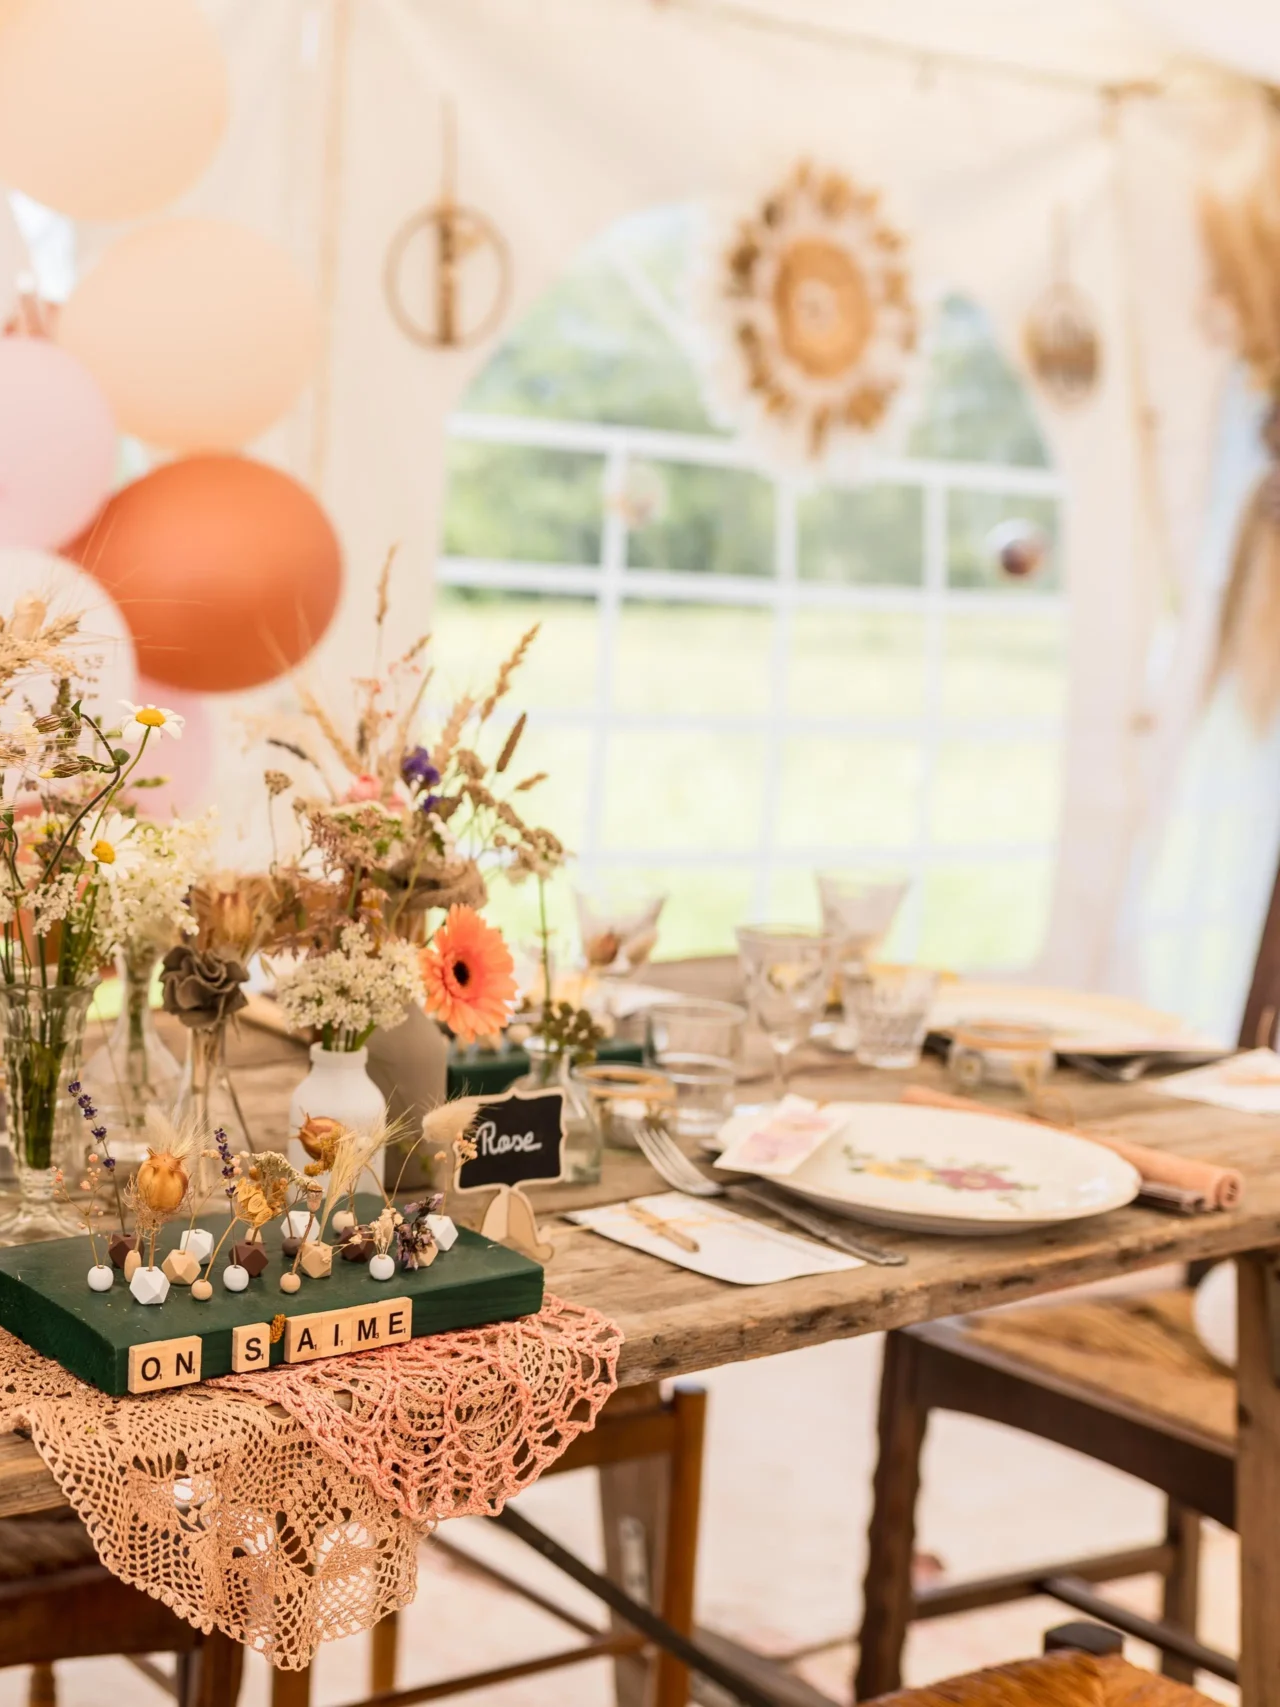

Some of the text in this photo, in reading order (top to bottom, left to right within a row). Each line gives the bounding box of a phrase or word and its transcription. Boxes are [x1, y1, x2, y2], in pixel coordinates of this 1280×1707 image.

[476, 1121, 542, 1156] Rose
[141, 1351, 193, 1382] ON
[297, 1311, 404, 1353] AIME
